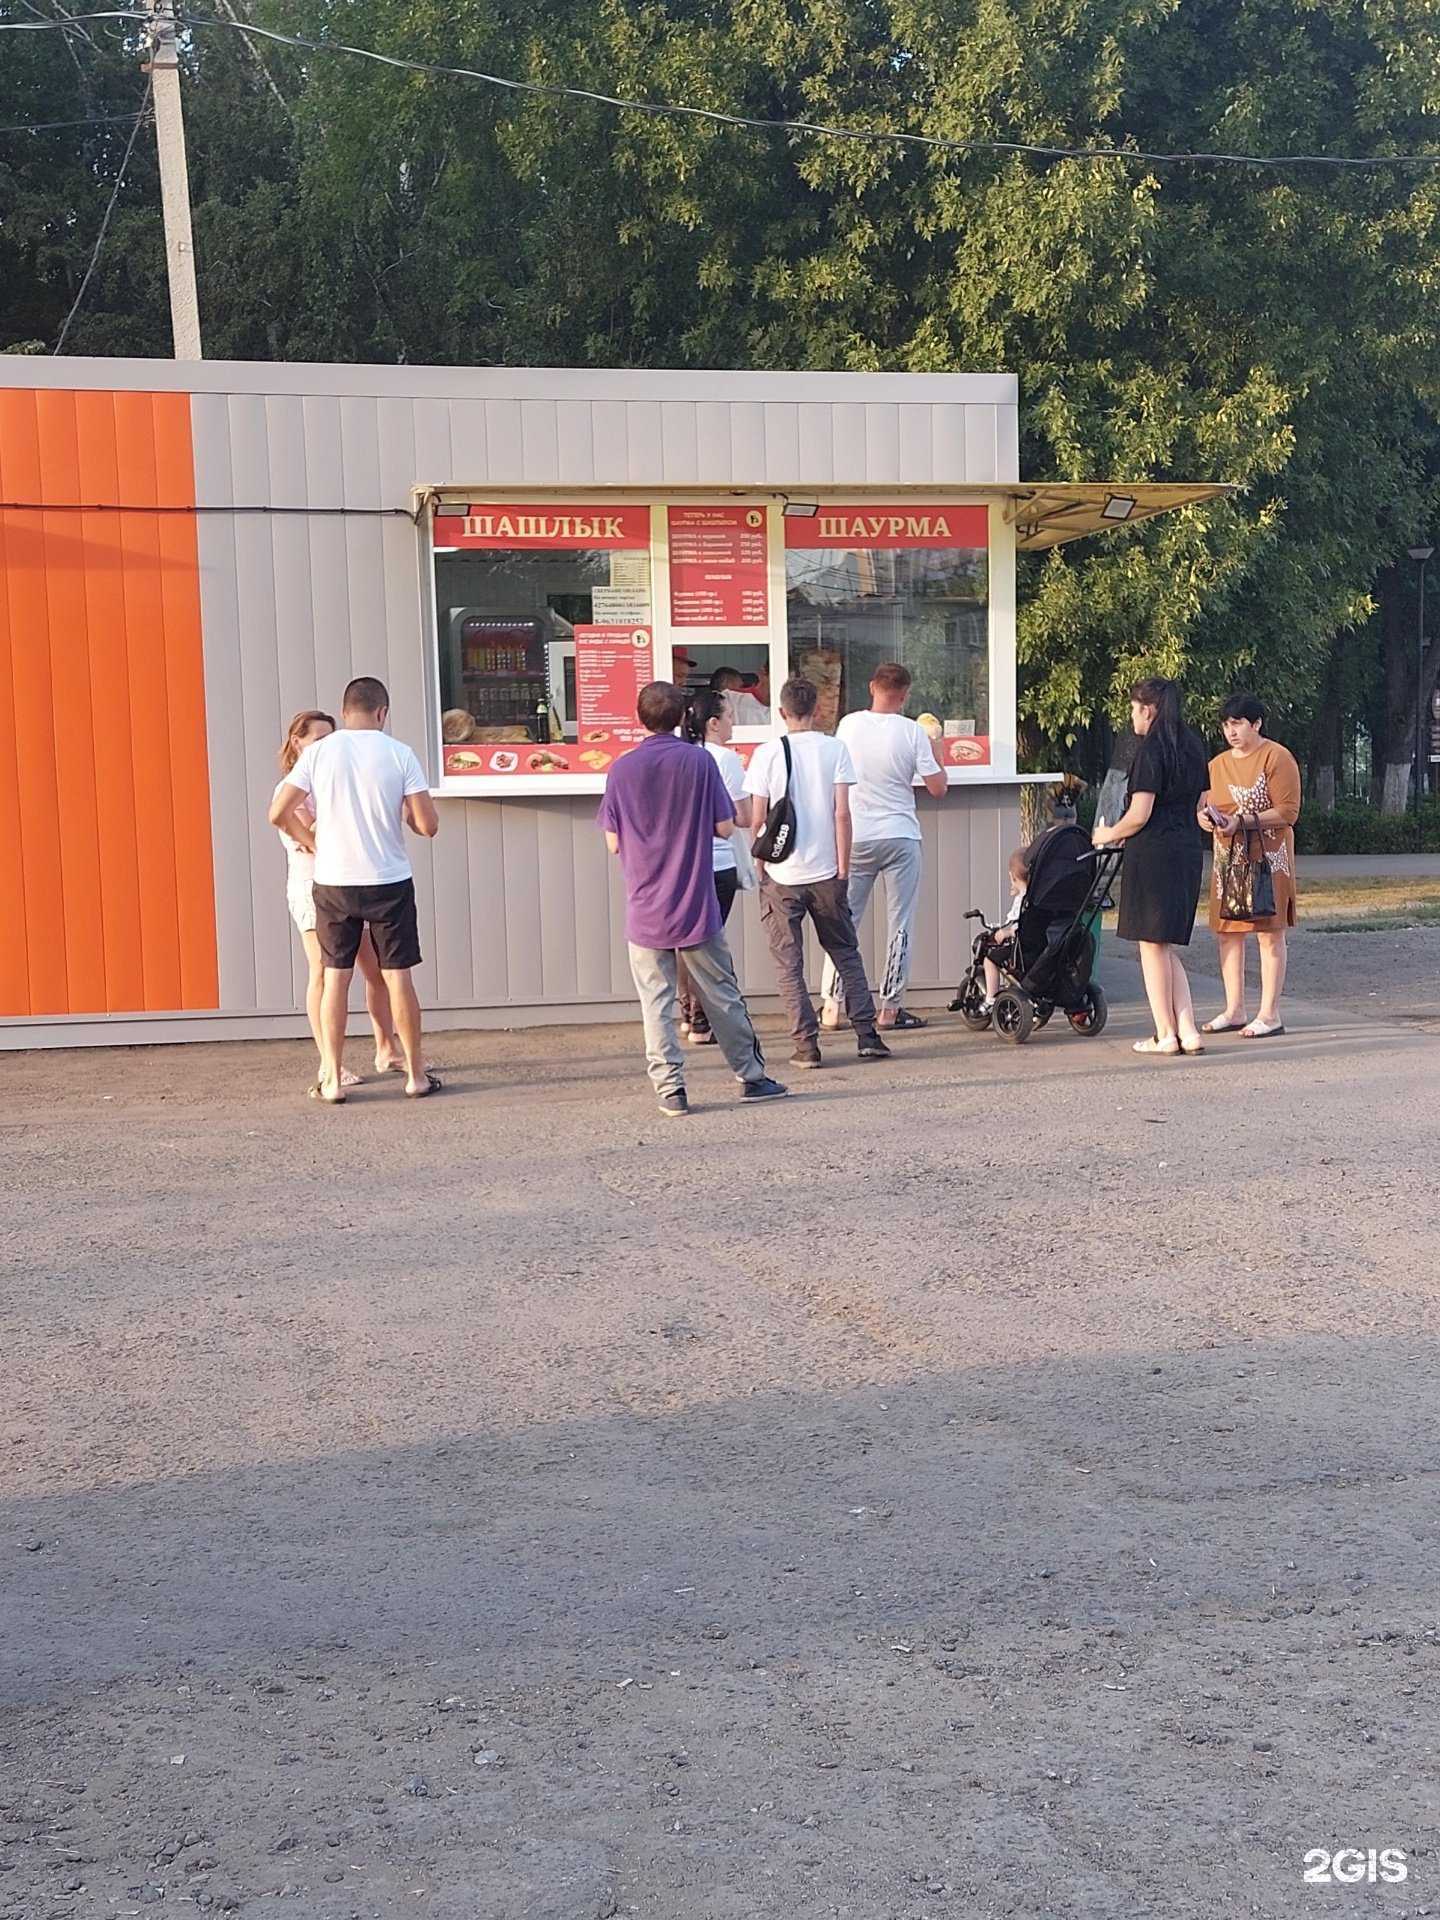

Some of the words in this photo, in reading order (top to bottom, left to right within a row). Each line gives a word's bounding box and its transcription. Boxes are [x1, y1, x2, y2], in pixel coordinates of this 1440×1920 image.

[462, 515, 625, 538] ШАШЛЫК
[818, 516, 952, 538] ШАУРМА
[771, 823, 790, 858] adidas
